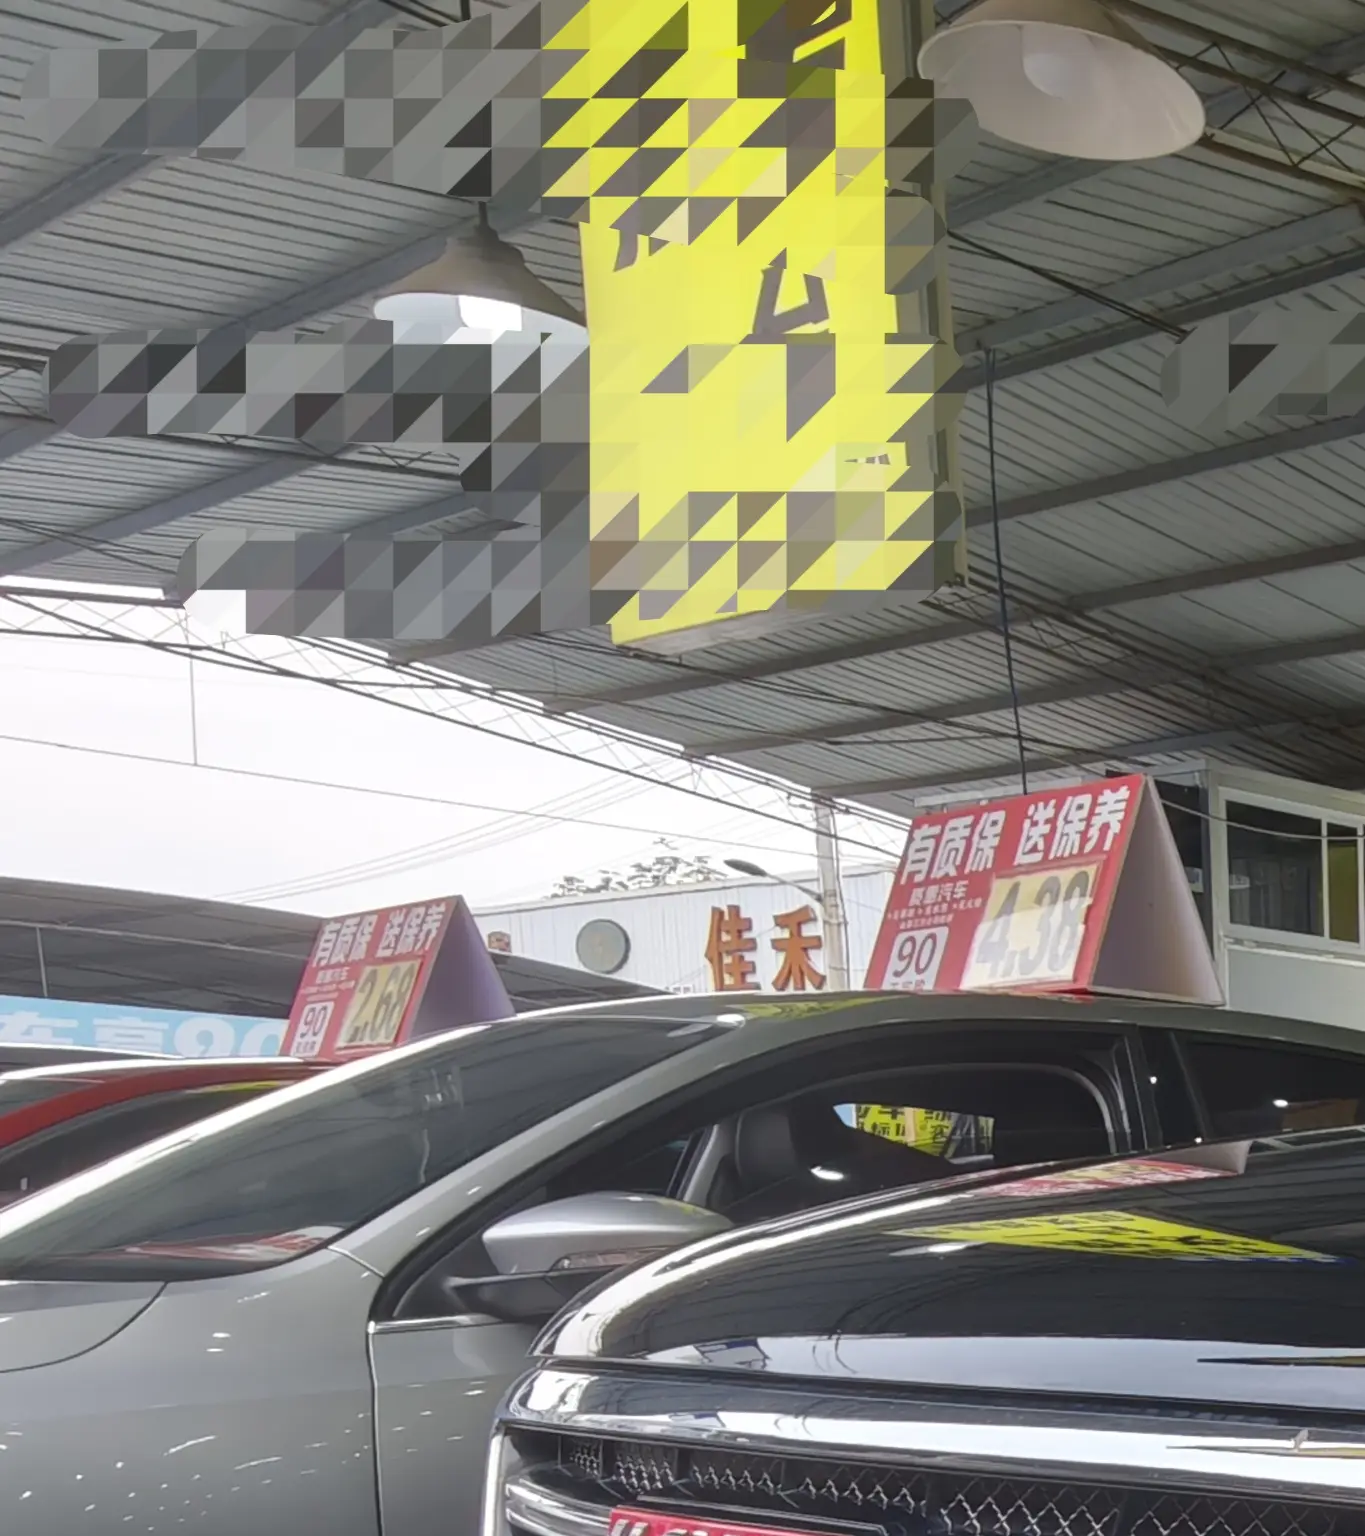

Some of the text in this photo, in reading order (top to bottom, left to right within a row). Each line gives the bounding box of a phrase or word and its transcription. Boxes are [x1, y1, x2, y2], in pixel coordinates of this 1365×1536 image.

[901, 784, 1130, 886] 有质保 送保养
[313, 903, 447, 967] 有质保 送保养
[705, 905, 826, 992] 佳禾
[893, 932, 937, 978] 90
[300, 1005, 328, 1039] 90
